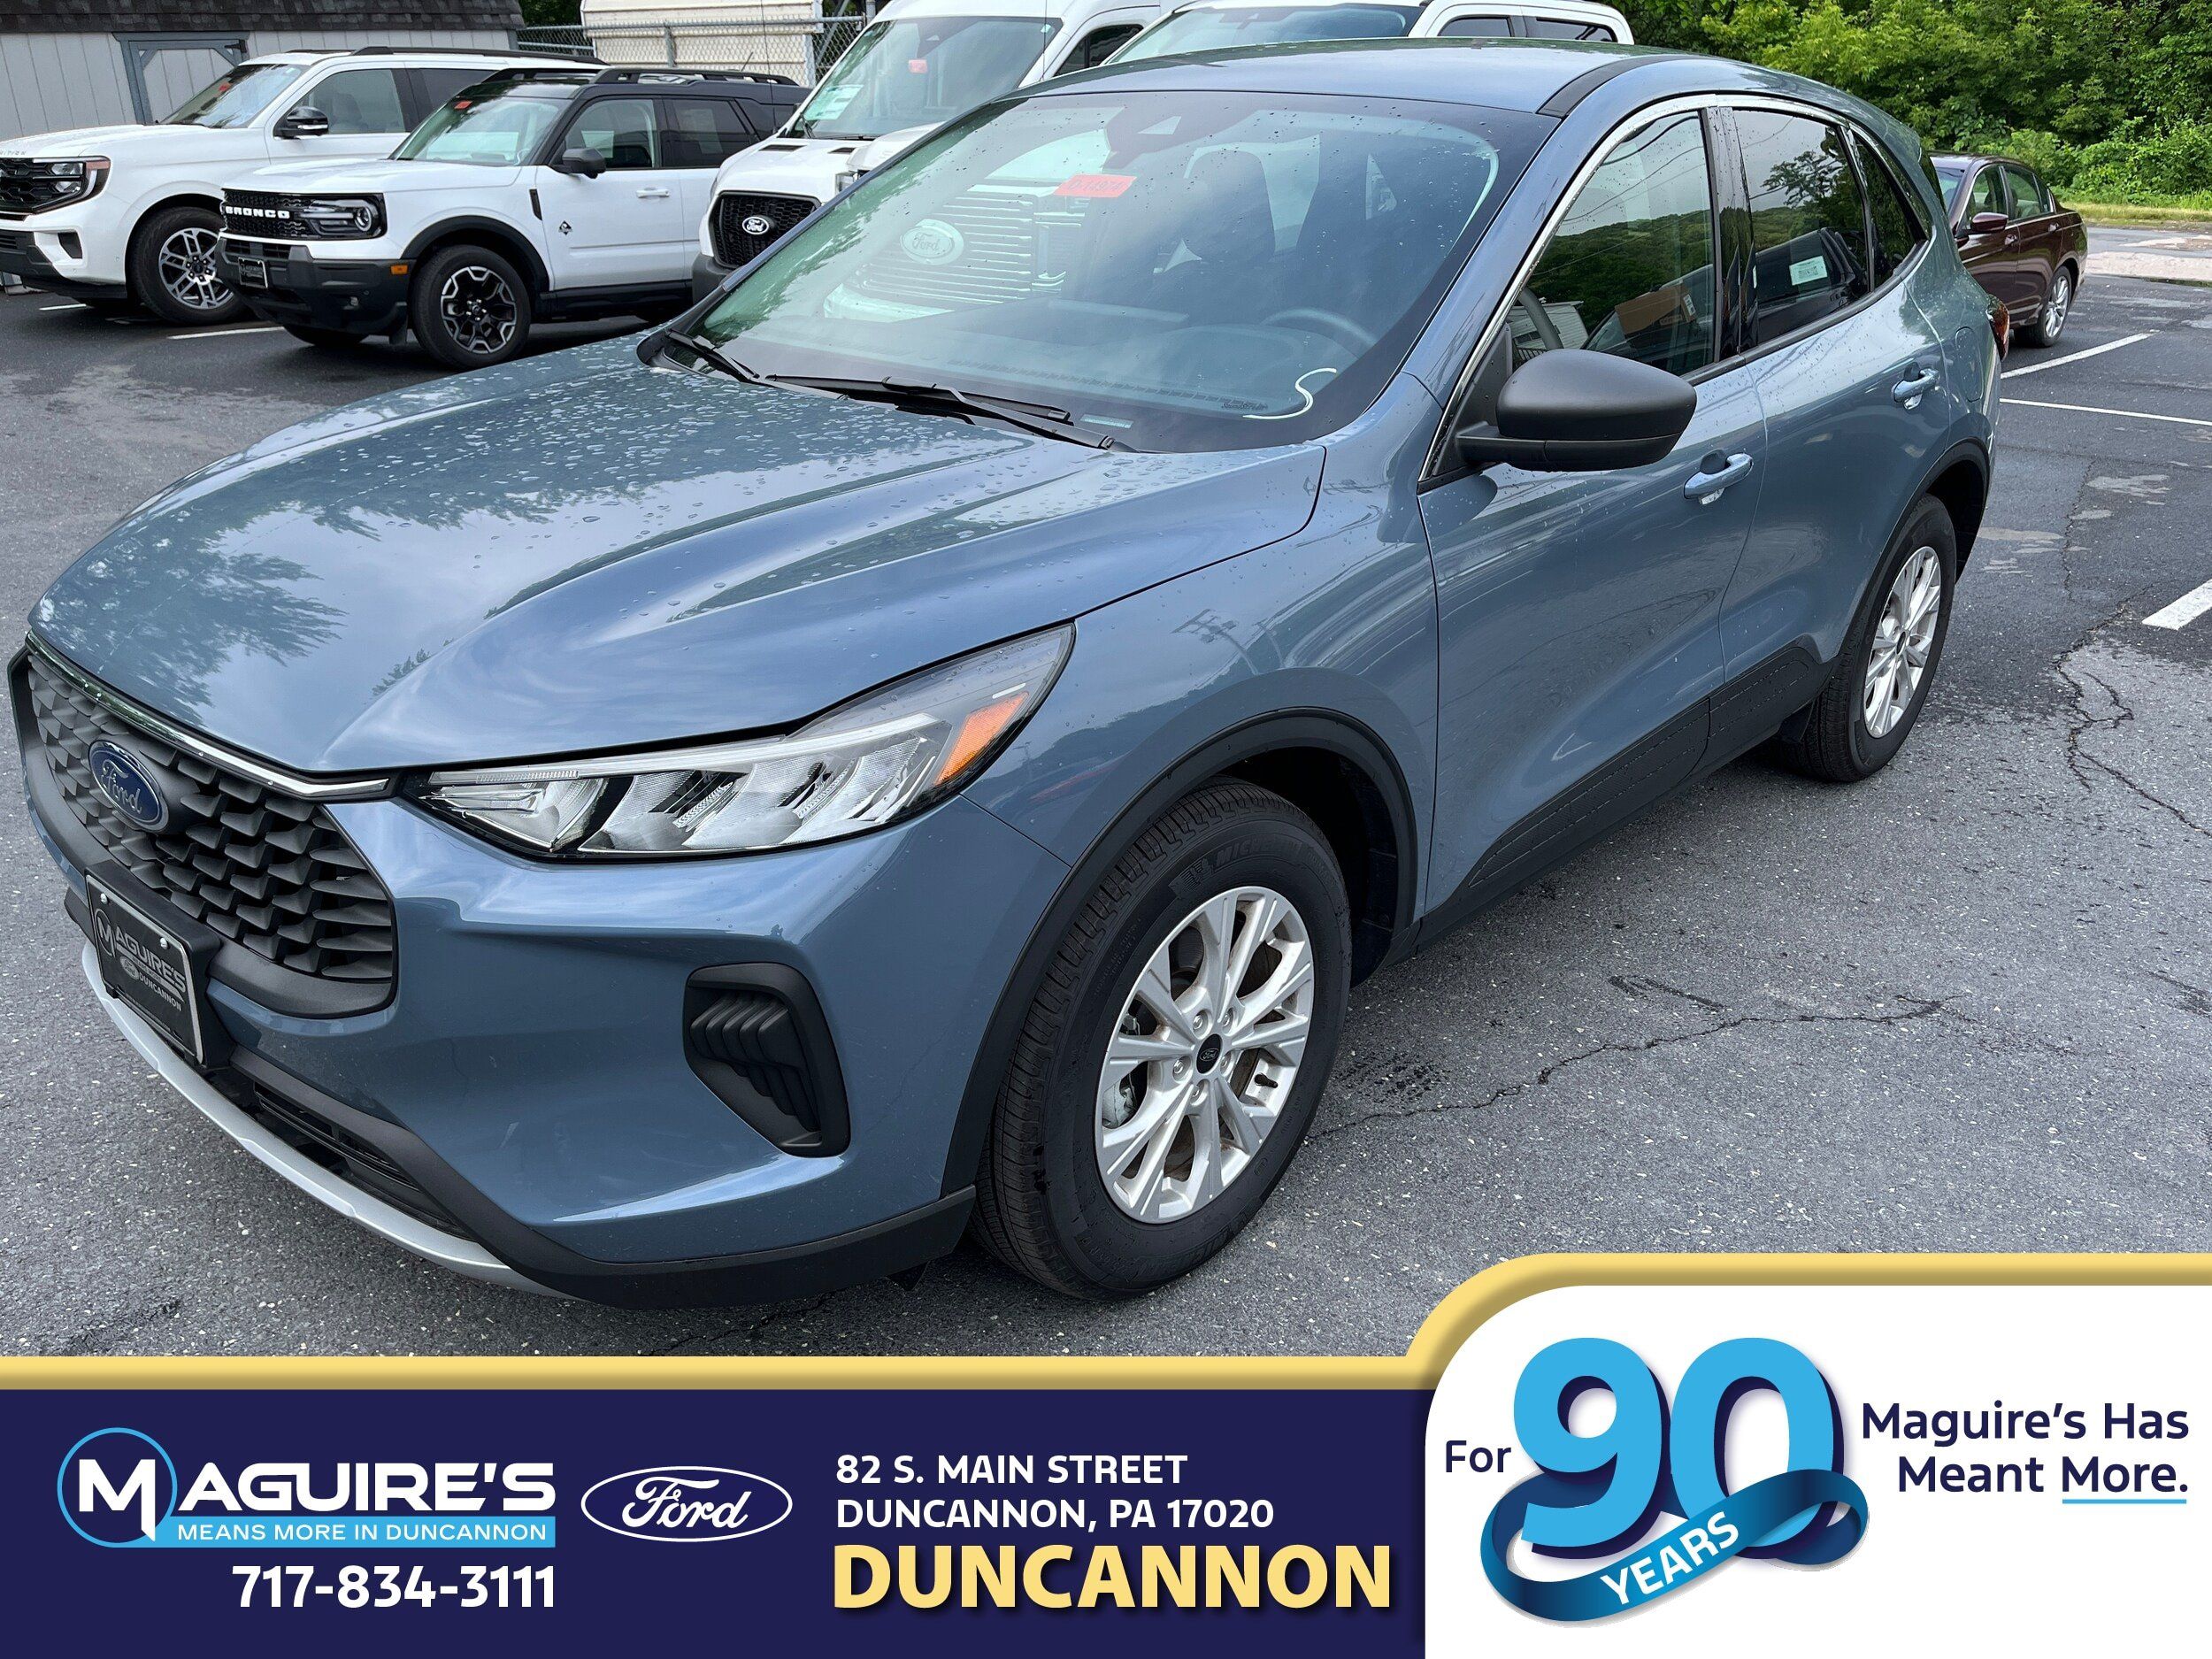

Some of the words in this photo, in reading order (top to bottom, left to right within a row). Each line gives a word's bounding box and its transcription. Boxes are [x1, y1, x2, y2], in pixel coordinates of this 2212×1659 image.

[225, 205, 290, 219] BRONCO
[746, 219, 764, 232] Ford
[912, 232, 940, 251] Ford
[100, 758, 142, 815] Ford
[96, 916, 187, 994] MAGUIRE'S
[138, 972, 182, 1012] DUNCANNON
